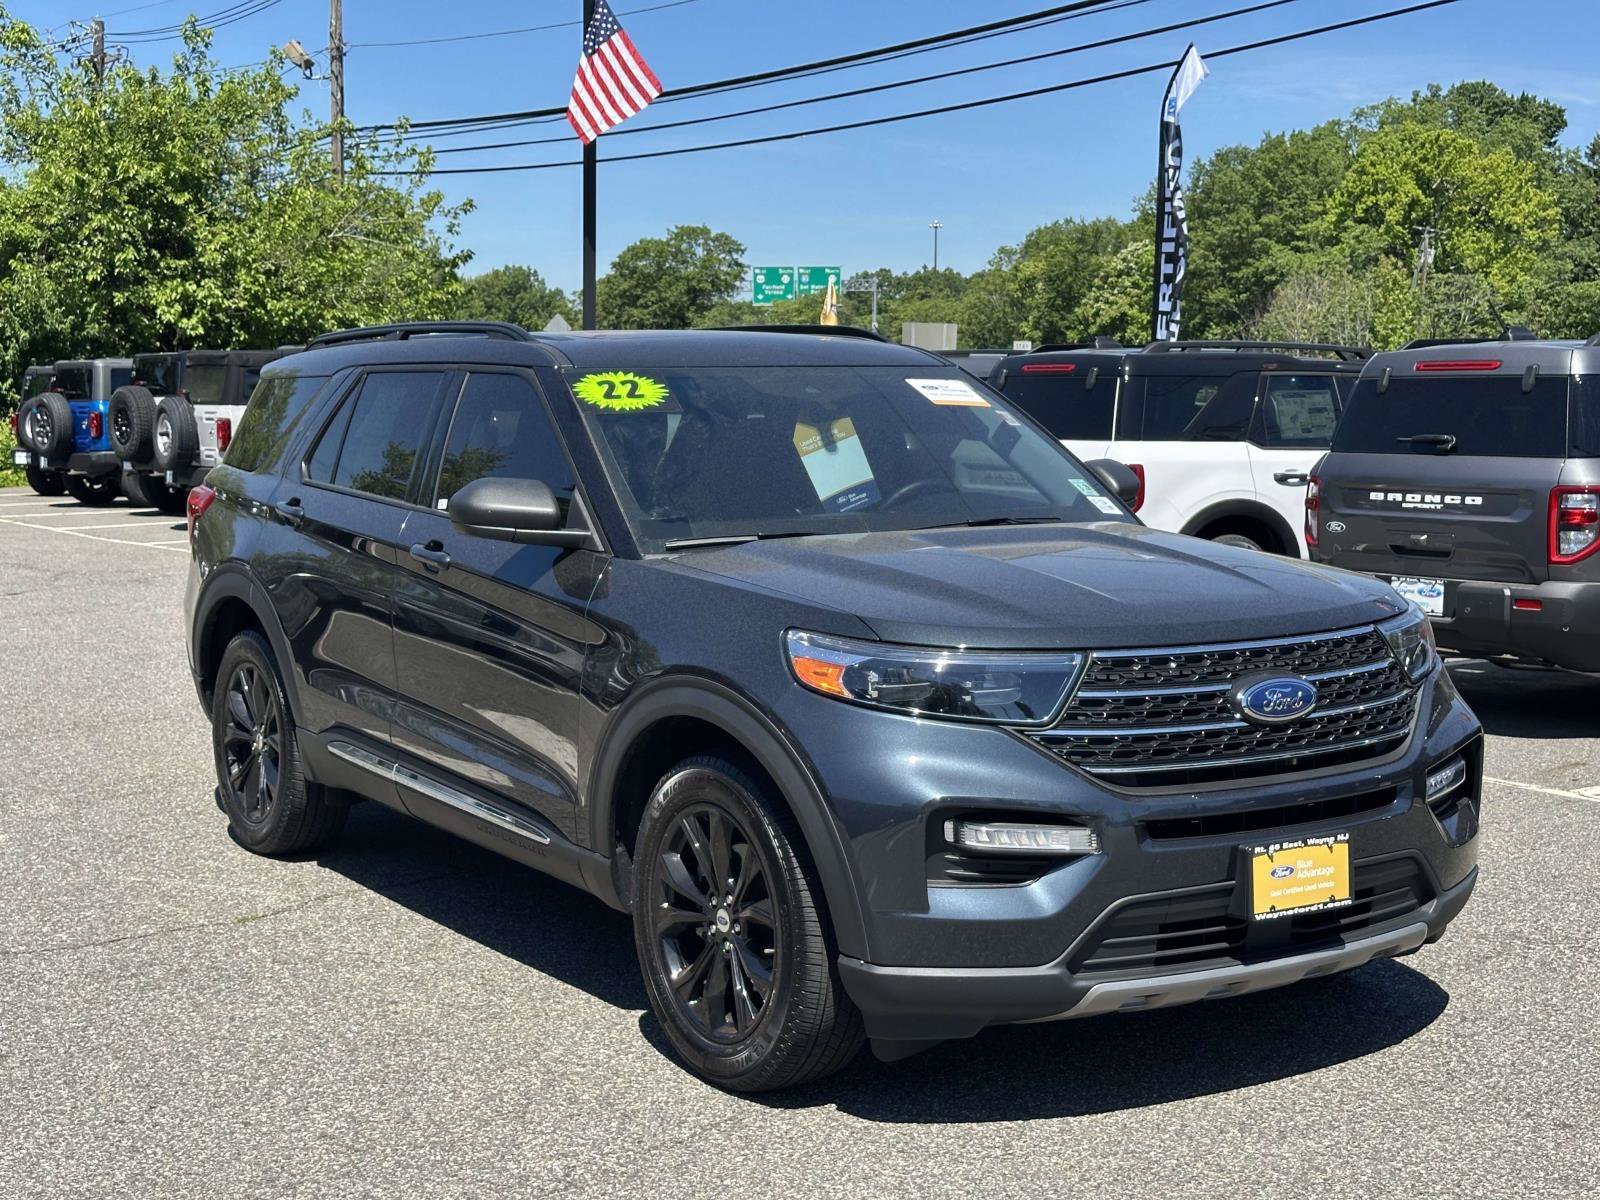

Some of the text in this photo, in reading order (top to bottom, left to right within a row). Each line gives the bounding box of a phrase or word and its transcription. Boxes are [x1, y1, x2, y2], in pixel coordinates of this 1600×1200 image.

[596, 380, 645, 399] 22
[1369, 492, 1483, 505] BRONCO
[1263, 687, 1303, 711] Ford
[1282, 840, 1305, 848] East,
[1307, 836, 1335, 846] Wayne
[1337, 833, 1350, 841] NJ
[1296, 860, 1313, 868] Blue
[1296, 866, 1335, 879] Advantage
